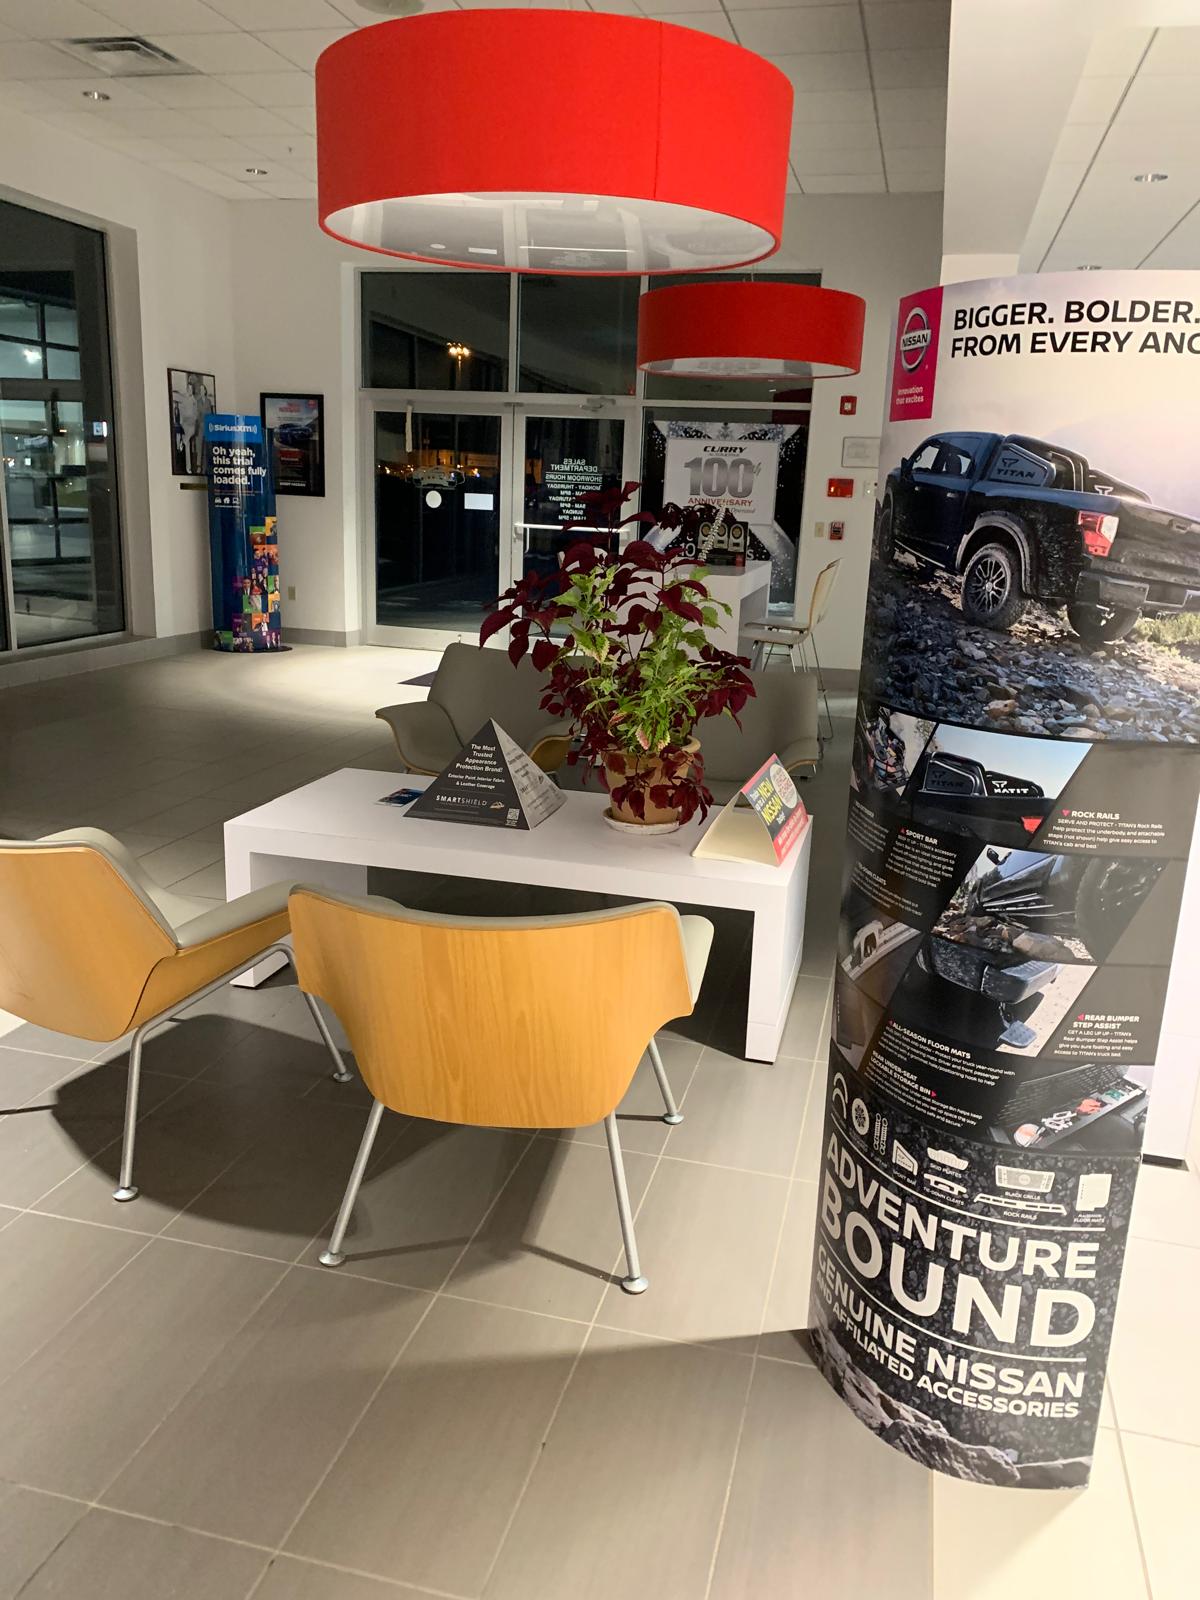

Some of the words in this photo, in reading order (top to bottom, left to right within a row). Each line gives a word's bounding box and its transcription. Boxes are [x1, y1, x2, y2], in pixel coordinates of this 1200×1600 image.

[954, 303, 1054, 330] BIGGER.
[1065, 300, 1200, 324] BOLDER.
[903, 332, 928, 347] NISSAN
[951, 333, 1021, 358] FROM
[1030, 331, 1133, 354] EVERY
[213, 447, 226, 455] Oh
[229, 448, 255, 458] yeah,
[703, 446, 748, 454] CURRY
[213, 456, 231, 465] this
[233, 457, 253, 466] trial
[213, 467, 246, 475] comes
[248, 467, 267, 477] fully
[214, 475, 251, 485] loaded.
[996, 468, 1036, 479] TITAN
[906, 829, 925, 840] SPORT
[925, 836, 938, 845] BAR
[1107, 1015, 1140, 1023] BUMPER
[892, 1022, 927, 1044] ALL-SEASON
[927, 1040, 951, 1053] FLOOR
[951, 1048, 971, 1060] MATS
[884, 1059, 918, 1081] UNDER-SEAT
[893, 1072, 919, 1090] STORAGE
[920, 1085, 931, 1095] BIN
[827, 1134, 1100, 1279] ADVENTURE
[821, 1168, 1097, 1348] BOUND
[818, 1244, 918, 1364] GENUINE
[927, 1346, 1086, 1398] NISSAN
[816, 1271, 833, 1305] AND
[832, 1303, 914, 1382] AFFILIATED
[917, 1374, 1080, 1419] ACCESSORIES
